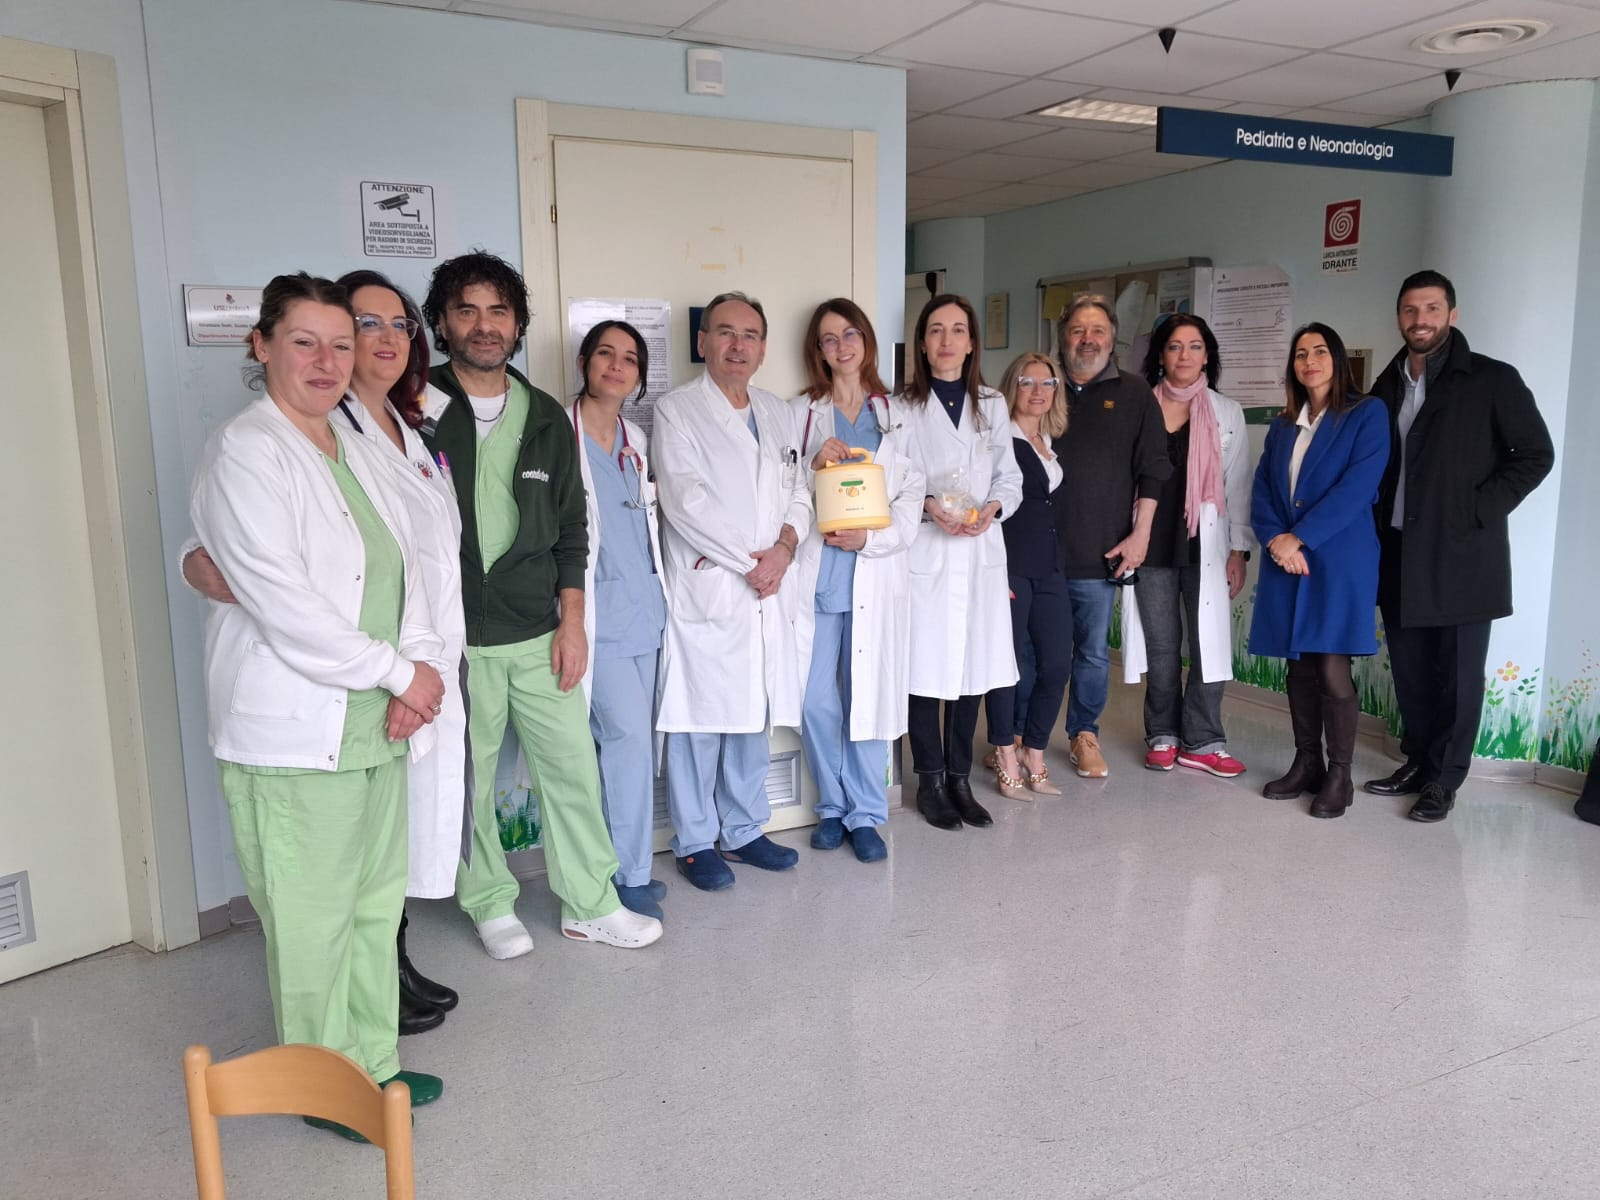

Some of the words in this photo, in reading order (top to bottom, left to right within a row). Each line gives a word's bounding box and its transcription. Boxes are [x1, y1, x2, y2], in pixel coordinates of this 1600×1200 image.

[1236, 128, 1294, 149] Pediatria
[1297, 137, 1307, 150] e
[1310, 136, 1394, 160] Neonatologia
[371, 183, 425, 194] ATTENZIONE
[1322, 257, 1358, 270] IDRANTE
